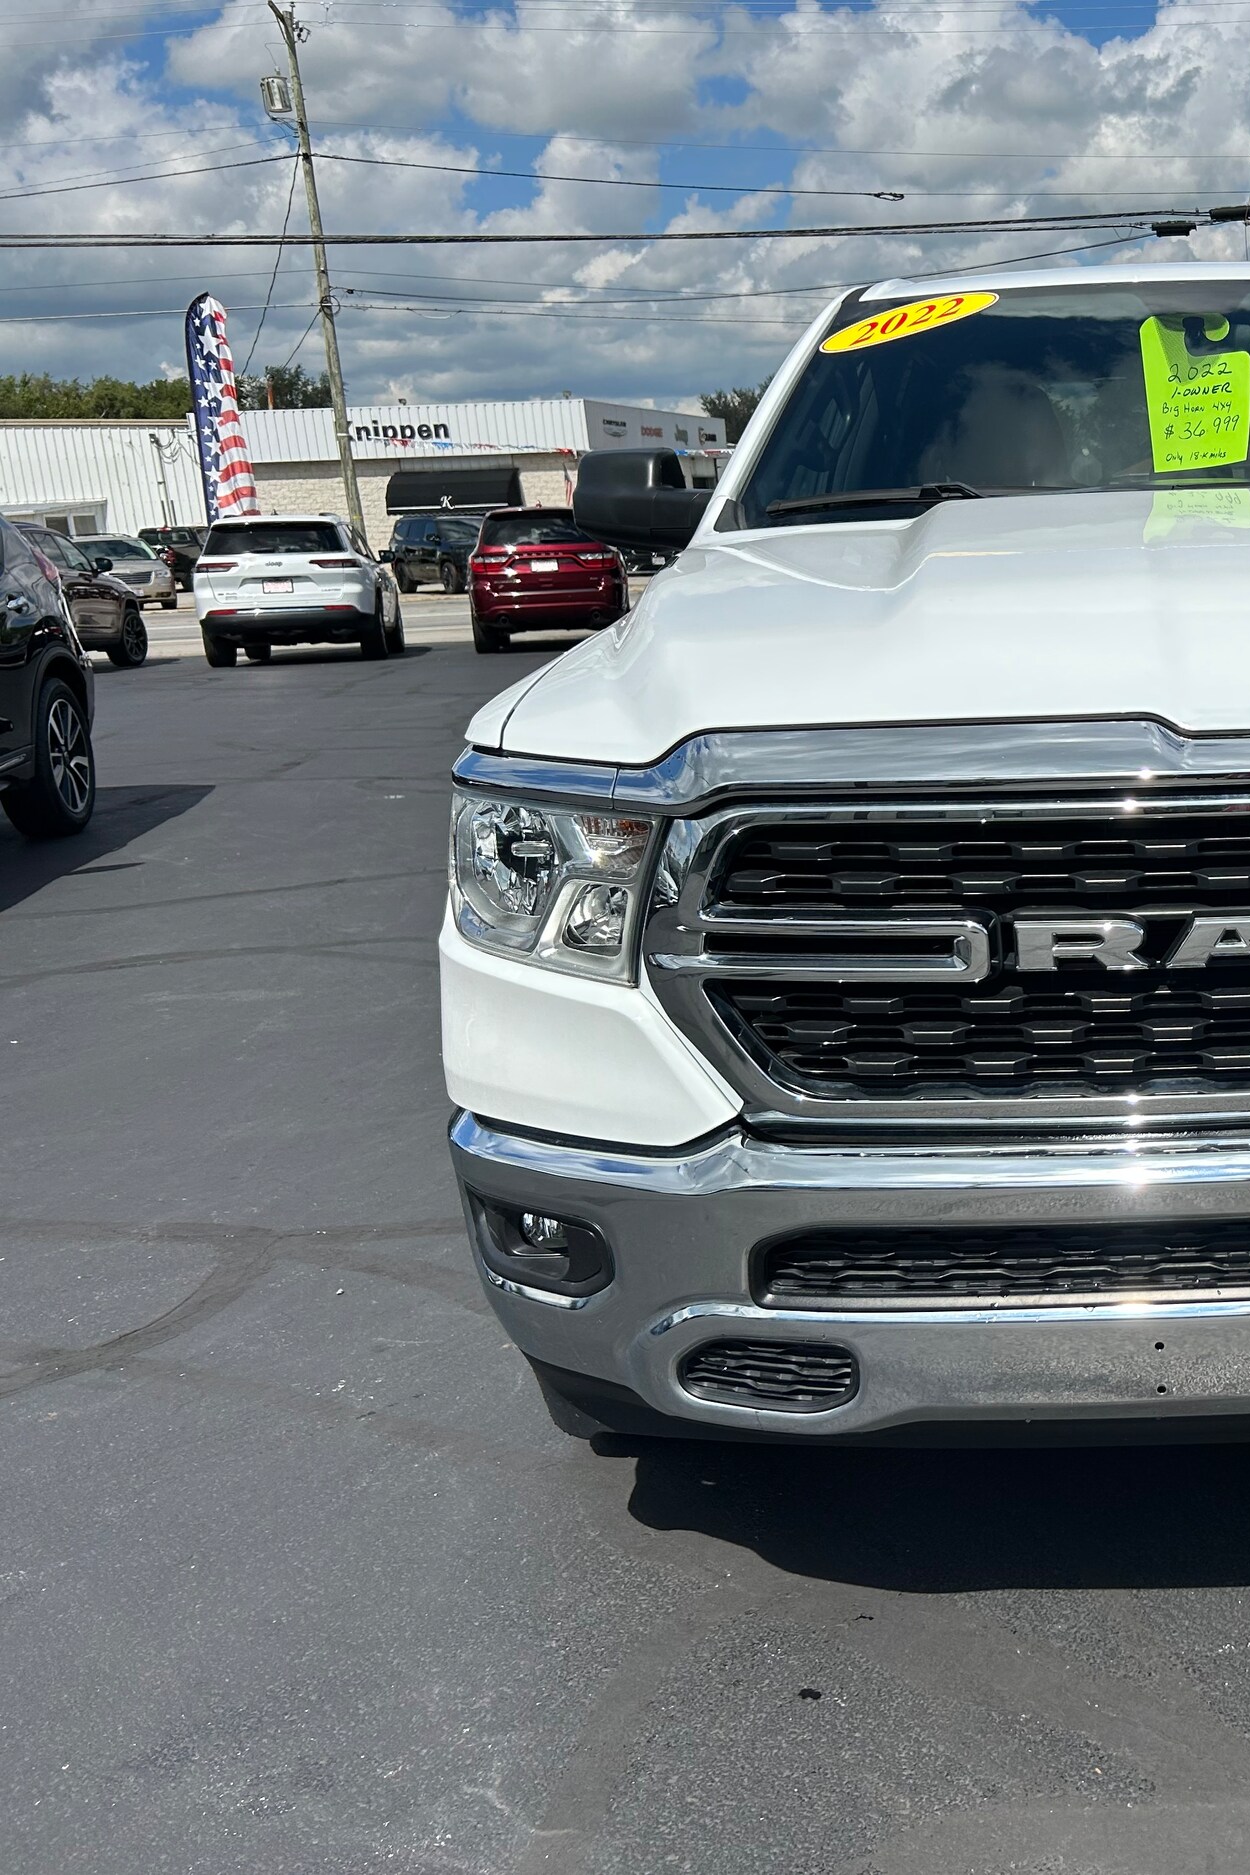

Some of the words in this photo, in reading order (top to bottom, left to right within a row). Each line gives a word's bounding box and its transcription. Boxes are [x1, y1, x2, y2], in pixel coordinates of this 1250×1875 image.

[849, 297, 965, 346] 2022
[1168, 362, 1232, 383] 2022
[1171, 382, 1232, 399] 1-OWNER
[1165, 451, 1183, 465] Only
[440, 495, 455, 510] K
